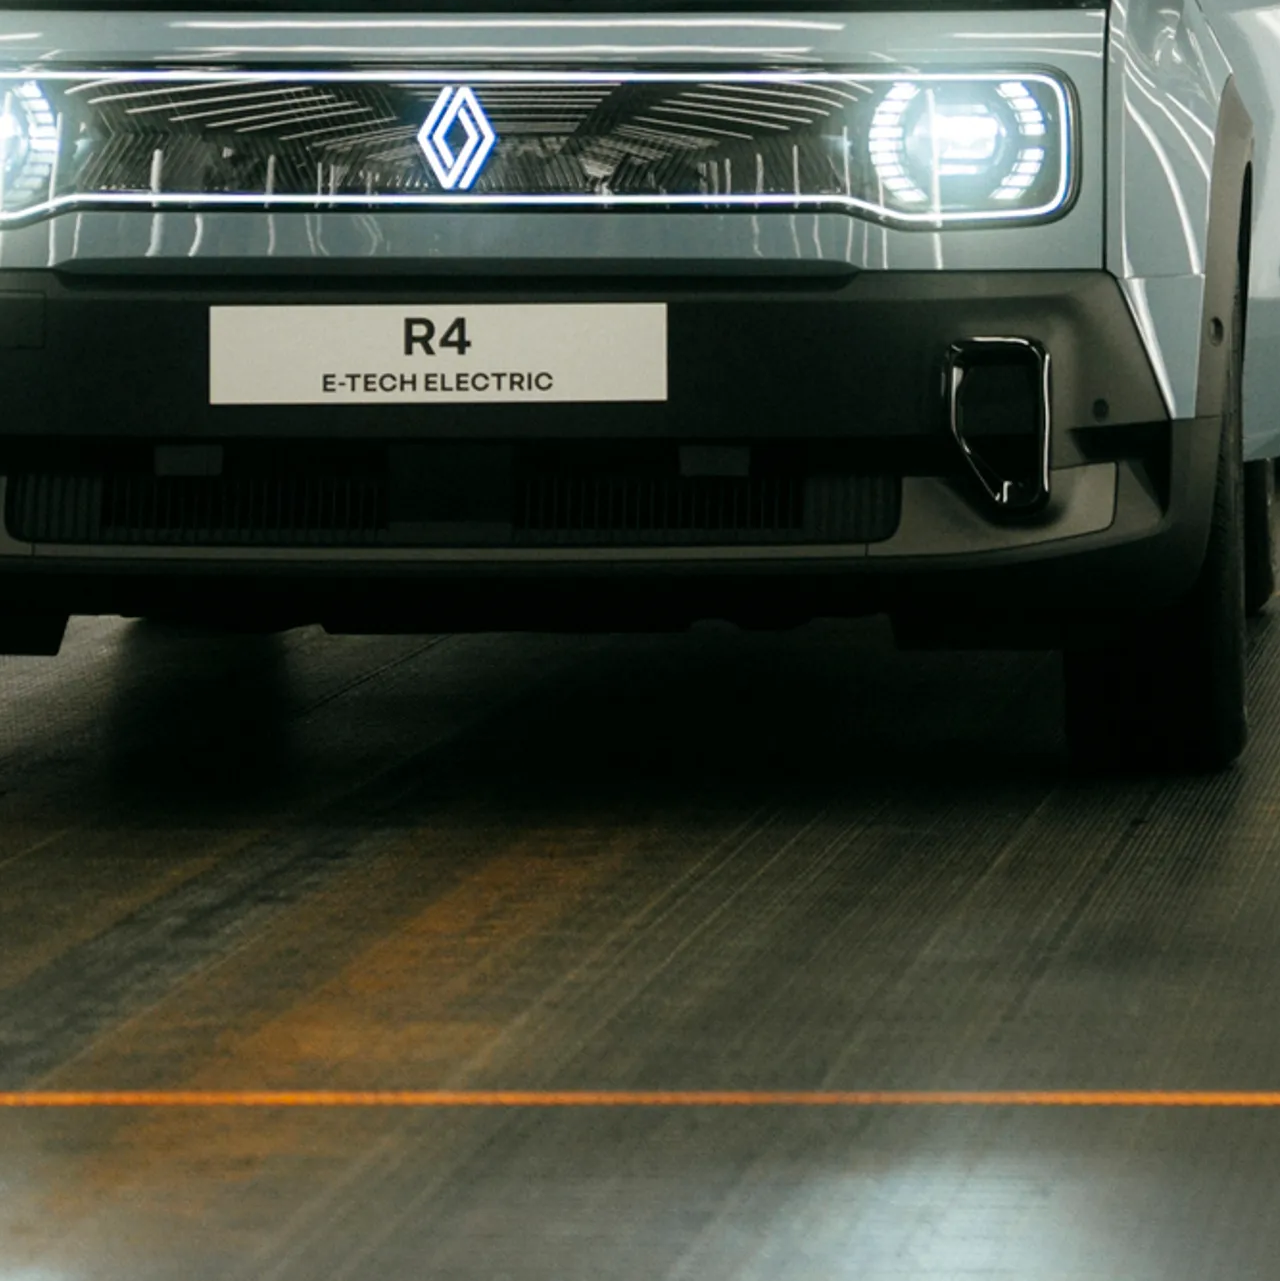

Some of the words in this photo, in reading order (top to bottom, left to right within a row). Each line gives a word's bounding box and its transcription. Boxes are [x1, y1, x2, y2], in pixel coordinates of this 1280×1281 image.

[403, 316, 472, 357] R4
[321, 372, 418, 393] E-TECH
[423, 371, 554, 392] ELECTRIC
